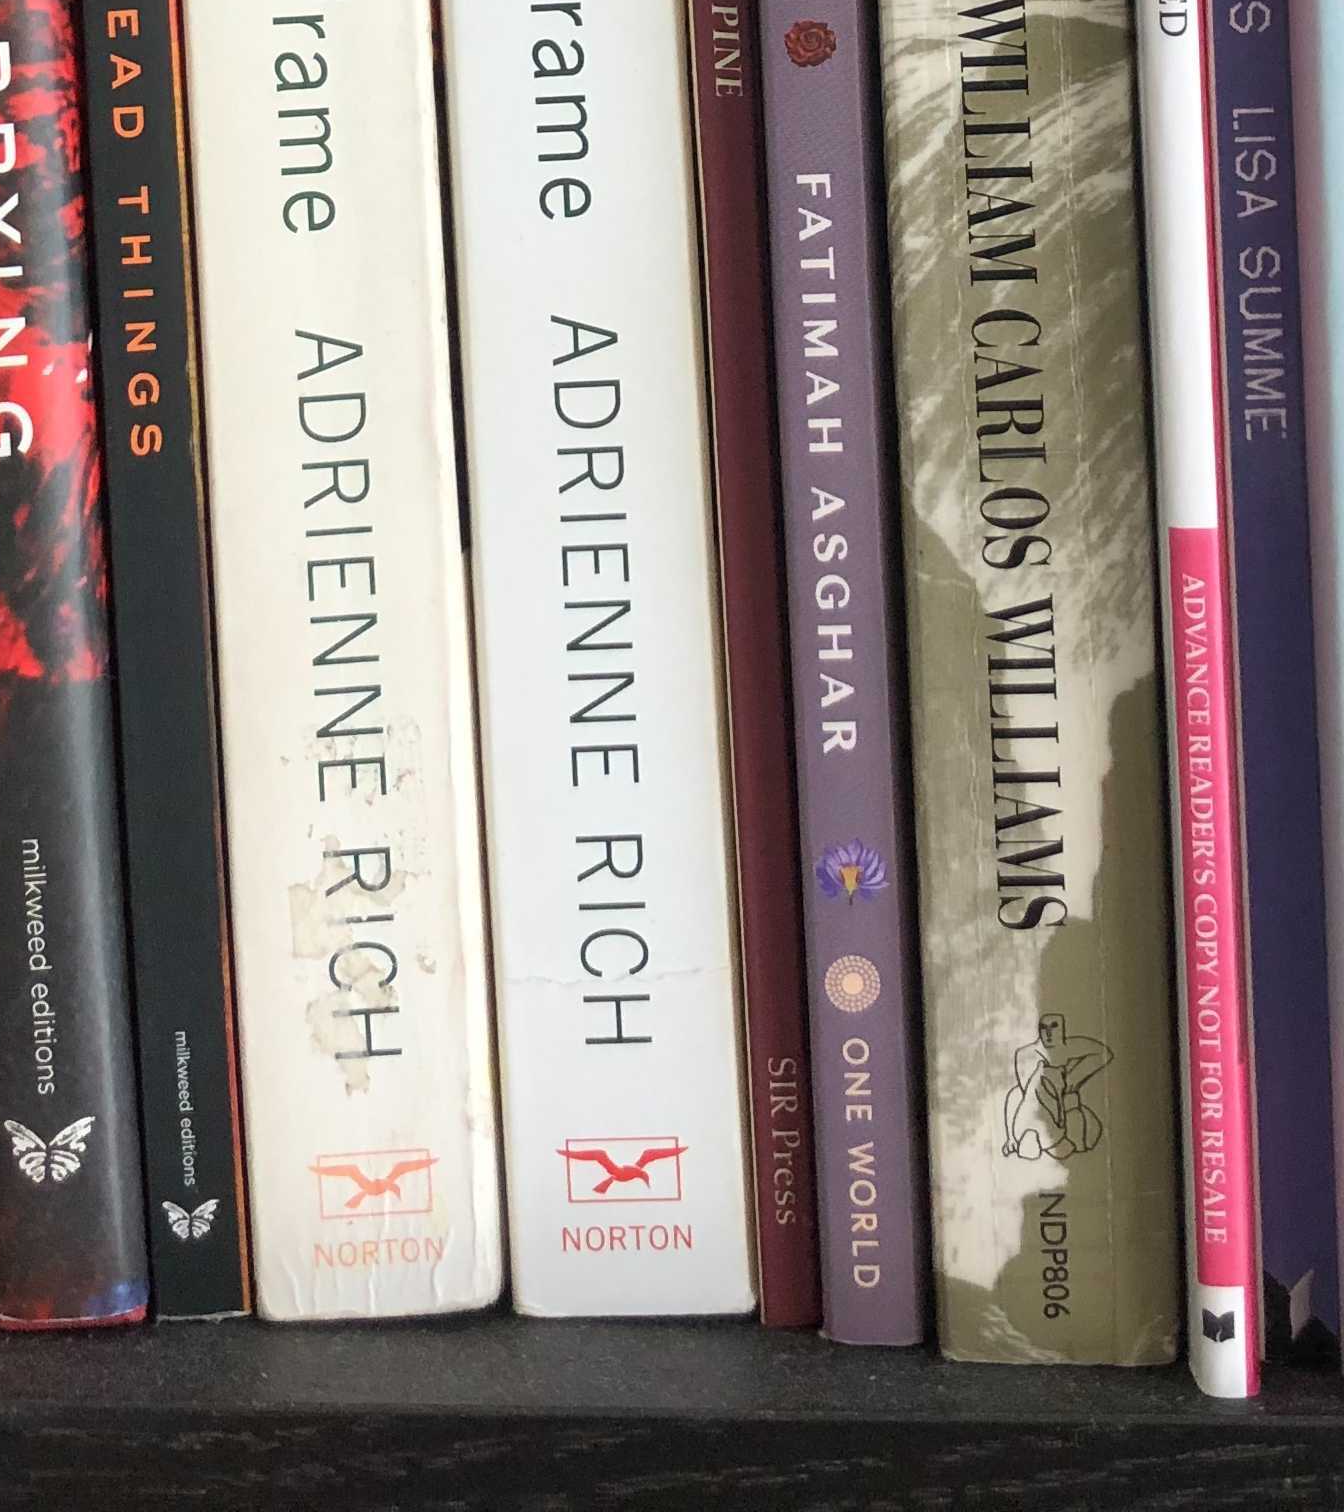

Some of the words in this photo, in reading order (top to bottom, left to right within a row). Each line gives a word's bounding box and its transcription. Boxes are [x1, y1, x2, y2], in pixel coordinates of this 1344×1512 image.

[711, 2, 744, 99] PINE
[1231, 106, 1277, 219] LISA
[117, 186, 163, 456] THINGS
[795, 172, 844, 454] FATIMAH
[1236, 244, 1288, 442] SUMME
[969, 307, 1053, 570] CARLOS
[295, 329, 387, 802] ADRIENNE
[550, 314, 640, 787] ADRIENNE
[809, 486, 858, 755] ASGHAR
[1181, 572, 1212, 728] ADVANCE
[985, 592, 1068, 932] WILLIAMS
[22, 838, 52, 970] milkweed
[323, 846, 403, 1060] RICH
[575, 834, 653, 1046] RICH
[1193, 892, 1220, 978] COPY
[31, 982, 55, 1096] editions
[175, 1030, 194, 1112] milkweed
[1197, 983, 1222, 1052] NOT
[767, 1056, 798, 1117] SIR
[841, 1037, 873, 1122] ONE
[1199, 1060, 1225, 1122] FOR
[180, 1117, 196, 1187] editions
[771, 1127, 801, 1226] Press
[1200, 1129, 1228, 1245] RESALE
[313, 1236, 444, 1268] NORTON
[562, 1224, 693, 1252] NORTON
[846, 1140, 881, 1289] WORLD
[1039, 1192, 1070, 1320] NDP806
